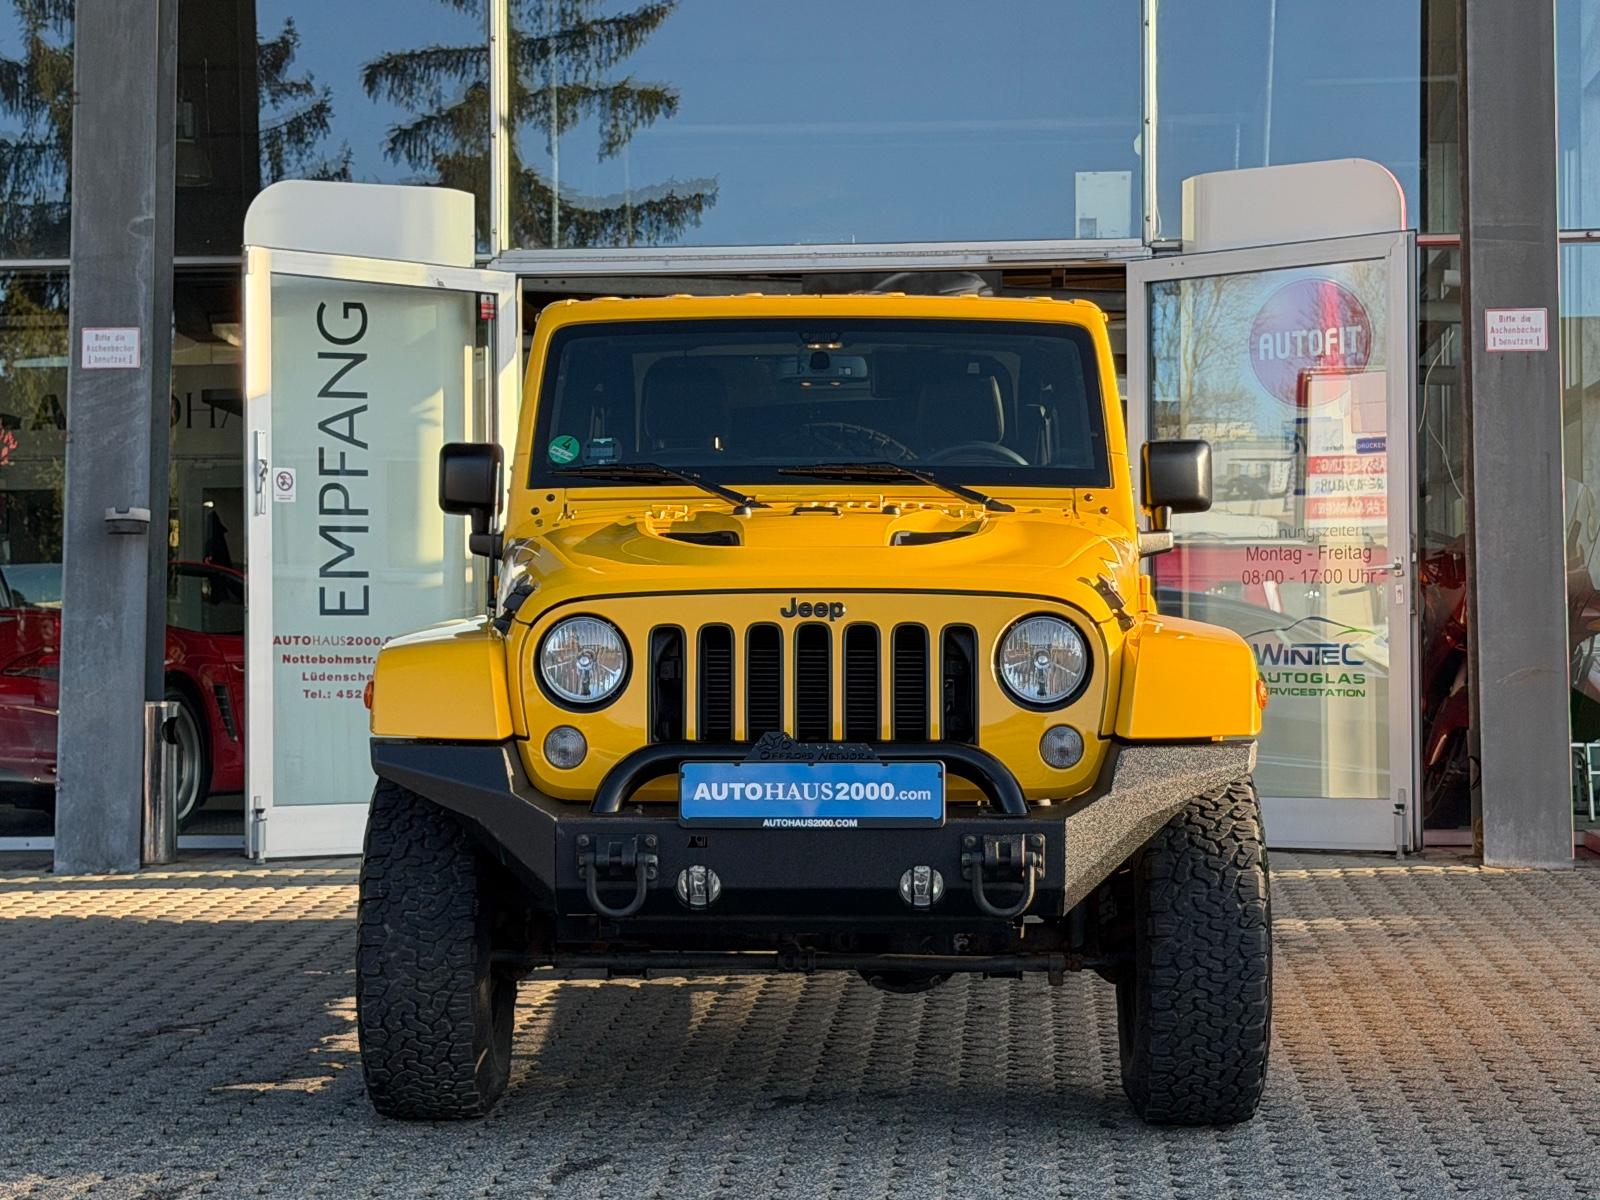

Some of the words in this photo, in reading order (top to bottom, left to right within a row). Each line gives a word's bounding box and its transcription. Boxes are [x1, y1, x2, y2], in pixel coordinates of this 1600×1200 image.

[1258, 325, 1362, 361] AUTOFIT
[562, 437, 572, 450] 4
[317, 301, 369, 616] EMPFANG
[1246, 546, 1302, 564] Montag
[1318, 545, 1372, 563] Freitag
[1242, 570, 1284, 585] 08:00
[1301, 569, 1342, 584] 17:00
[1348, 569, 1376, 584] Uhr
[780, 597, 844, 622] Jeep
[282, 654, 376, 664] Nottebohmstr.
[1259, 672, 1366, 684] AUTOGLAS
[303, 689, 332, 699] Tel.:
[1266, 687, 1366, 698] RVICESTATION
[693, 782, 932, 801] AUTOHAUS2000.com
[762, 818, 858, 828] AUTOHAUS2000.COM
